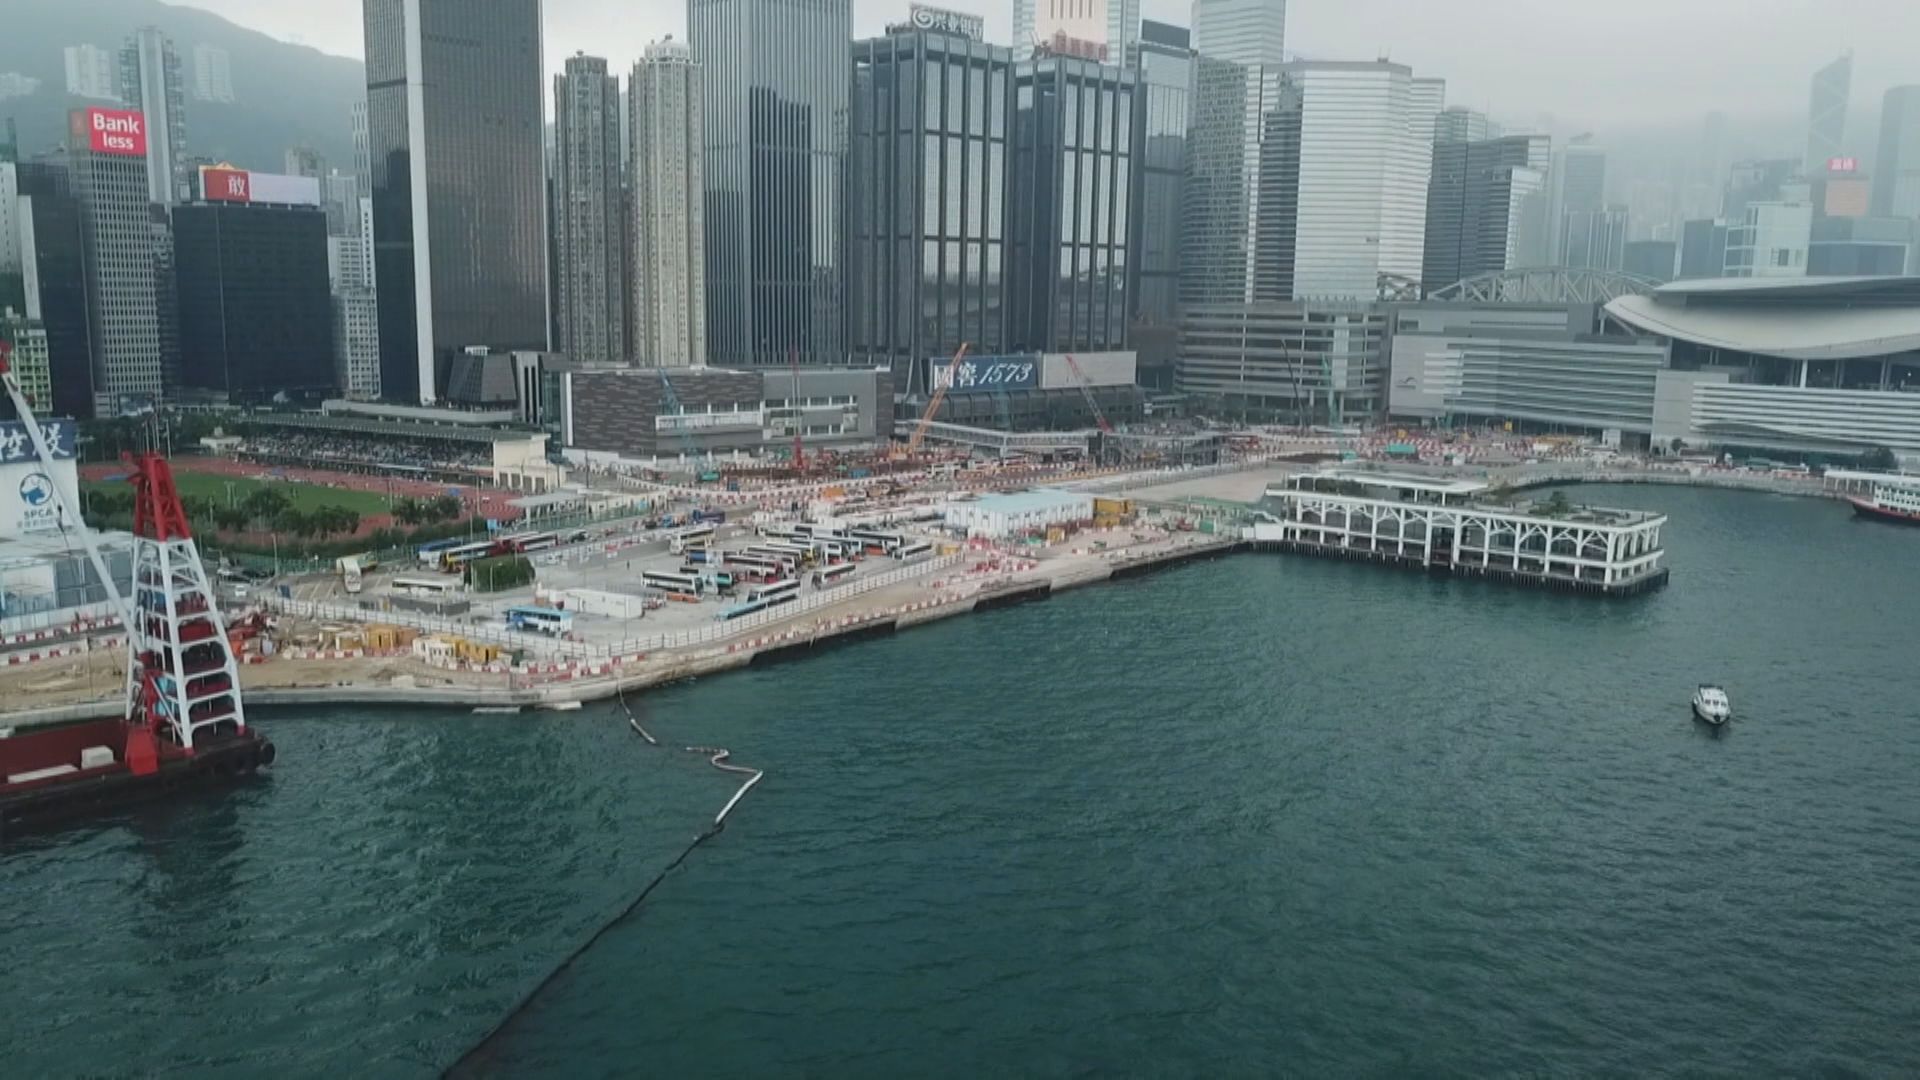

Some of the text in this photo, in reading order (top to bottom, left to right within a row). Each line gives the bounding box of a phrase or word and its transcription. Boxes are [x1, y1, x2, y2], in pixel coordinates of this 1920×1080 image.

[93, 112, 140, 134] Bank
[103, 131, 134, 150] less
[24, 508, 53, 520] SPCA
